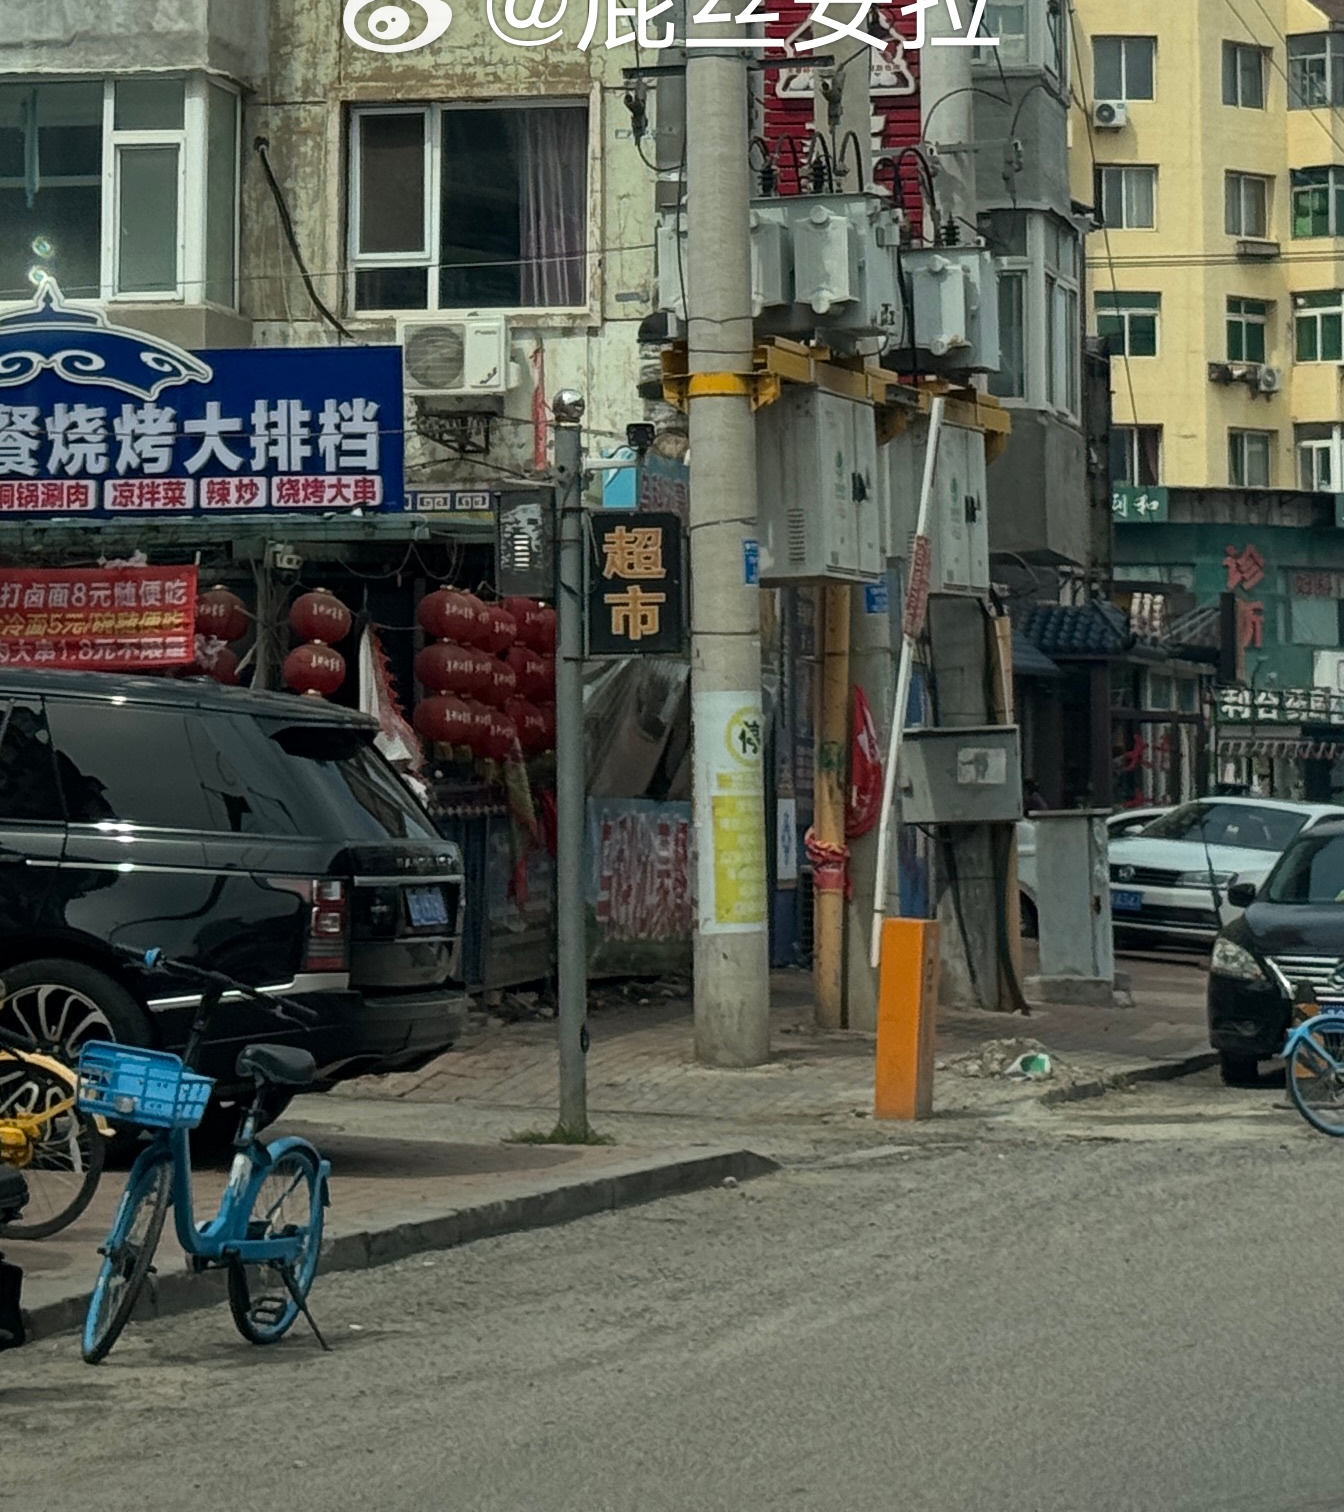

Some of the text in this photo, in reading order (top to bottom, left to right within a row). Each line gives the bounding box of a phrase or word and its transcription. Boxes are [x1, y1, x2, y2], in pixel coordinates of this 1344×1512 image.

[111, 481, 187, 508] 凉拌菜
[206, 479, 260, 506] 辣炒
[276, 477, 377, 505] 烧烤大串
[602, 525, 666, 641] 超市
